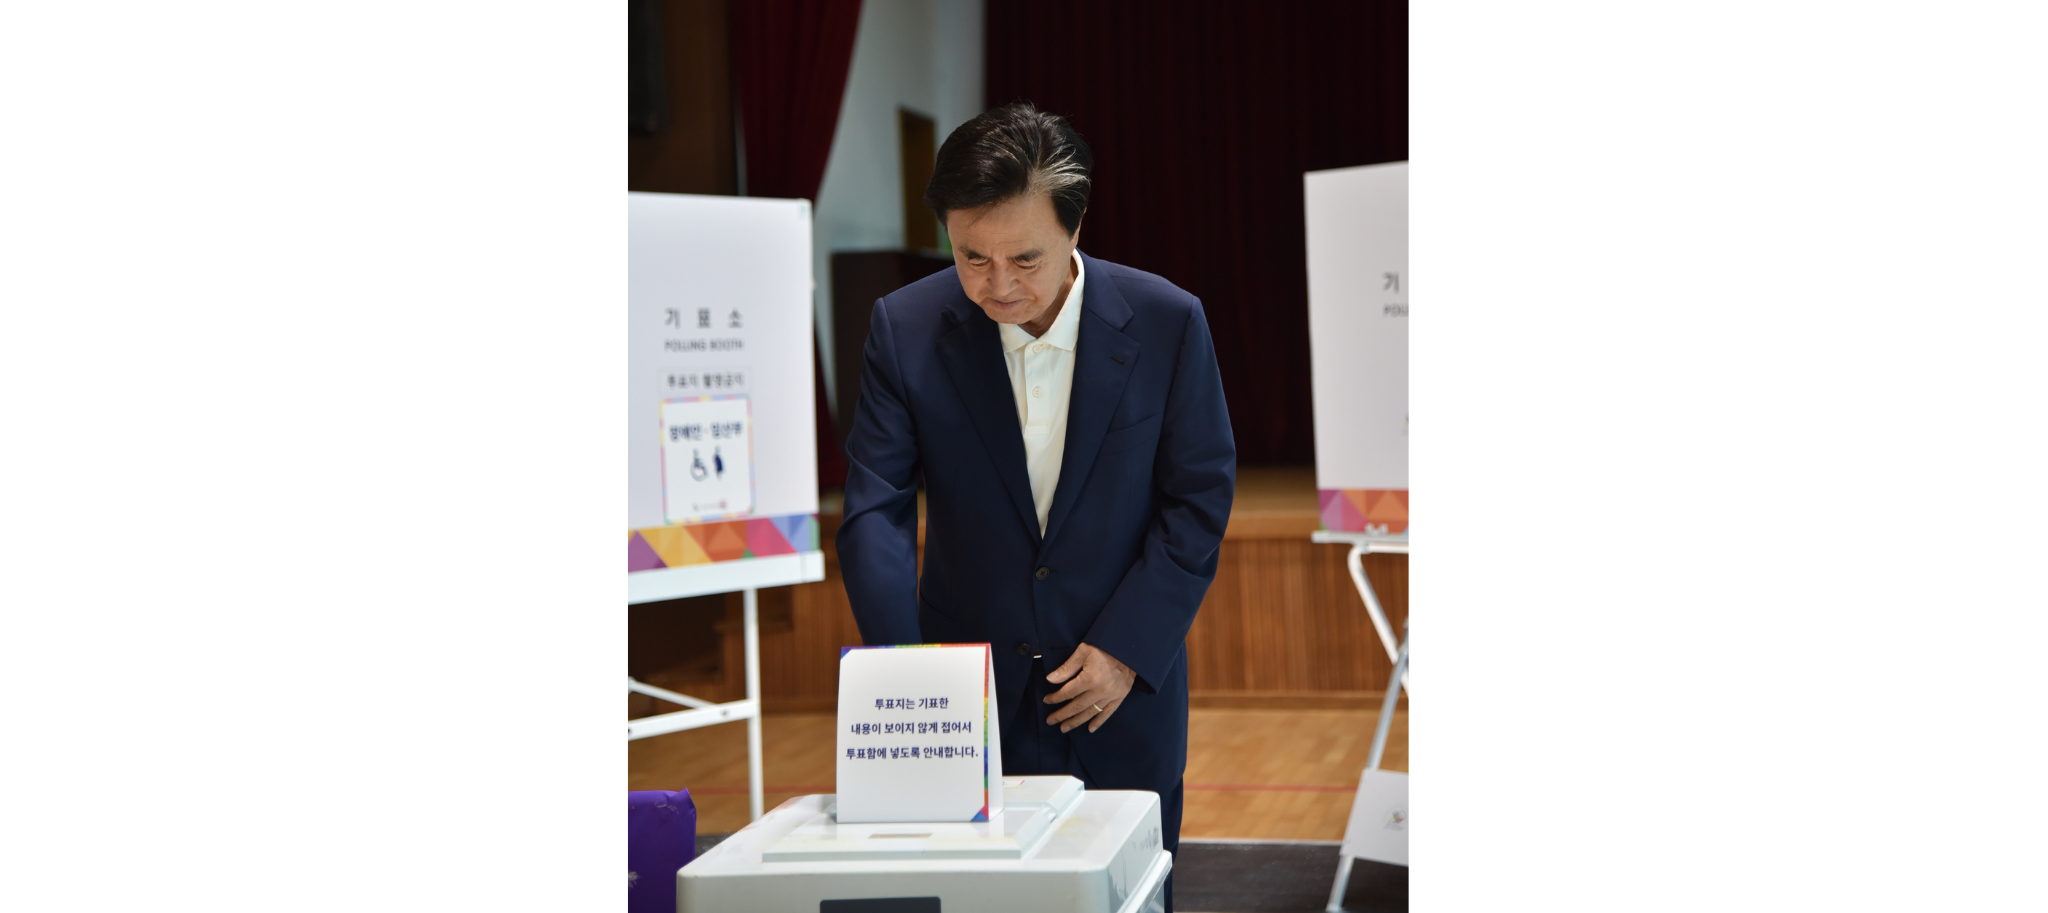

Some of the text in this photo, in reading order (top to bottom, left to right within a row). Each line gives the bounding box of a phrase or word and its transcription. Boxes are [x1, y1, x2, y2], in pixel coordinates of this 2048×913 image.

[664, 339, 743, 352] POLLING BOOTH
[667, 374, 698, 389] 투표지
[669, 423, 702, 442] 장애인
[710, 421, 742, 439] 임산부
[874, 697, 949, 711] 투표지는 기표한
[851, 721, 972, 736] 내용이 보이지 않게 접어서
[845, 746, 979, 761] 투표함에 넣도록 안내합니다.
